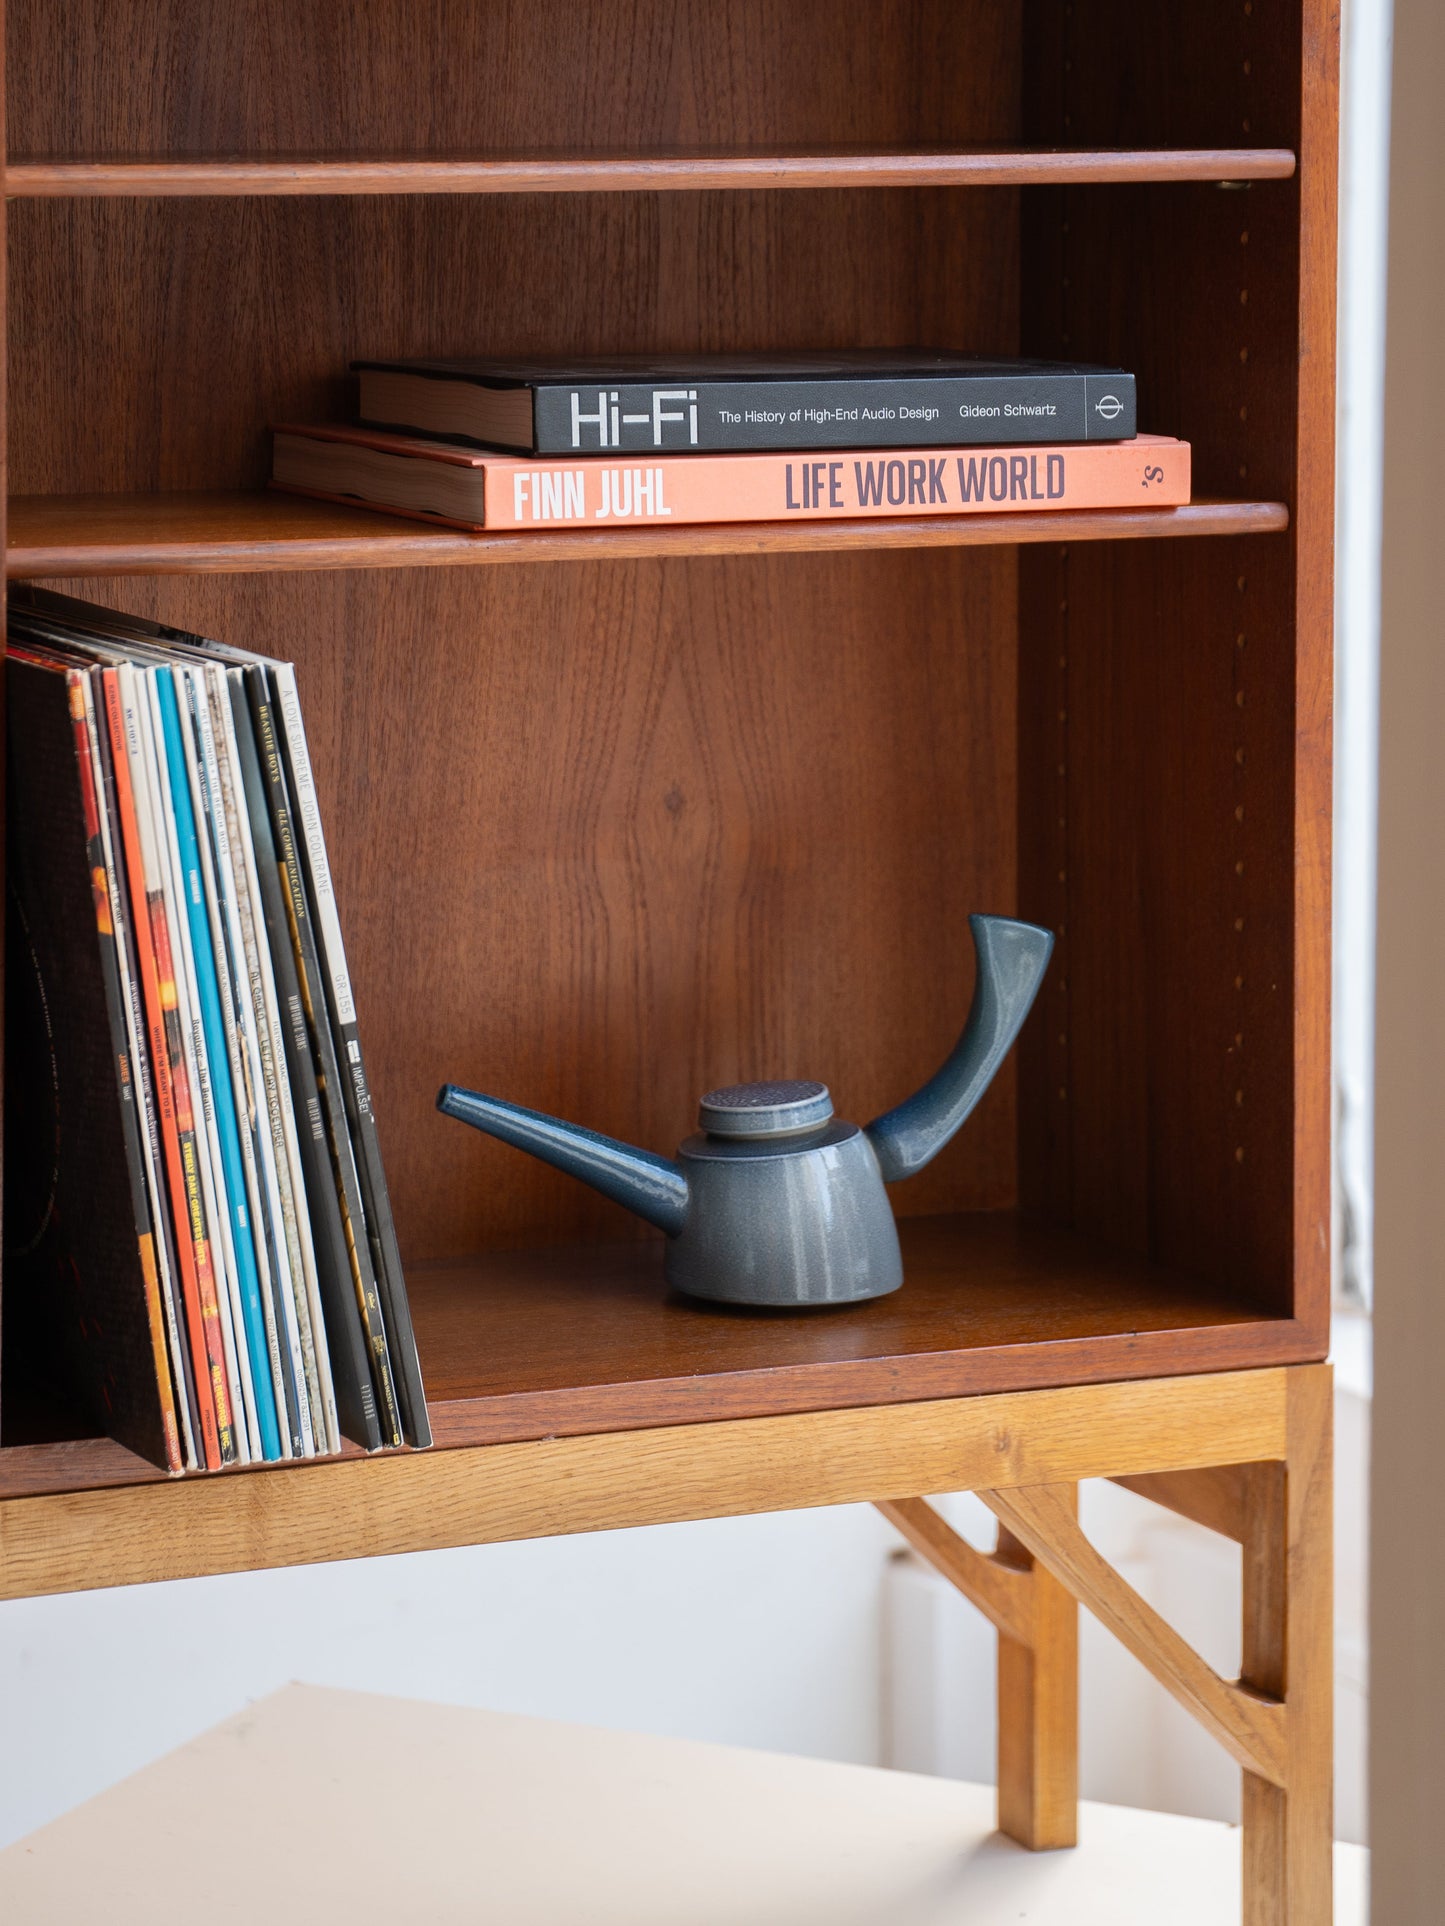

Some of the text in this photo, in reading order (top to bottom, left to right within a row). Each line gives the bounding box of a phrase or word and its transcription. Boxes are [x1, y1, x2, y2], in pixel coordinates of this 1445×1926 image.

[571, 391, 698, 447] Hi-Fi
[719, 407, 940, 425] The History of High-End Audio Design
[959, 404, 1057, 418] Gideon Schwartz
[513, 468, 672, 521] FINN JUHL
[785, 454, 1065, 509] LIFE WORK WORLD
[107, 684, 122, 751] EZRA COLLECTIVE
[204, 730, 214, 766] SOUNDS
[256, 705, 281, 783] BEASTIE BOYS
[211, 777, 219, 795] THE
[282, 689, 330, 896] A LOVE SUPREME JOHN COLTRANE
[214, 797, 223, 827] BEACH
[218, 830, 227, 854] BOYS
[277, 808, 305, 919] ILL COMMUNICATION
[250, 971, 260, 984] AL
[287, 994, 303, 1026] MUMFORD
[152, 1025, 161, 1054] WHERE
[191, 1018, 204, 1058] Revolver
[272, 1020, 283, 1061] FLEETWOOD
[278, 1063, 286, 1080] MAC
[294, 1033, 307, 1050] SONS
[118, 1053, 128, 1083] JAMES
[158, 1068, 167, 1094] MEANT
[198, 1067, 207, 1083] The
[162, 1097, 169, 1106] TO
[201, 1087, 212, 1121] Beatles
[351, 1066, 369, 1114] IMPULSE!
[163, 1107, 171, 1119] BE
[268, 1095, 284, 1148] TOGETHER
[305, 1097, 323, 1140] WILDER MIND
[182, 1141, 193, 1174] STEELY
[195, 1244, 206, 1265] HITS
[211, 1364, 230, 1449] ABC RECORDS, INC.
